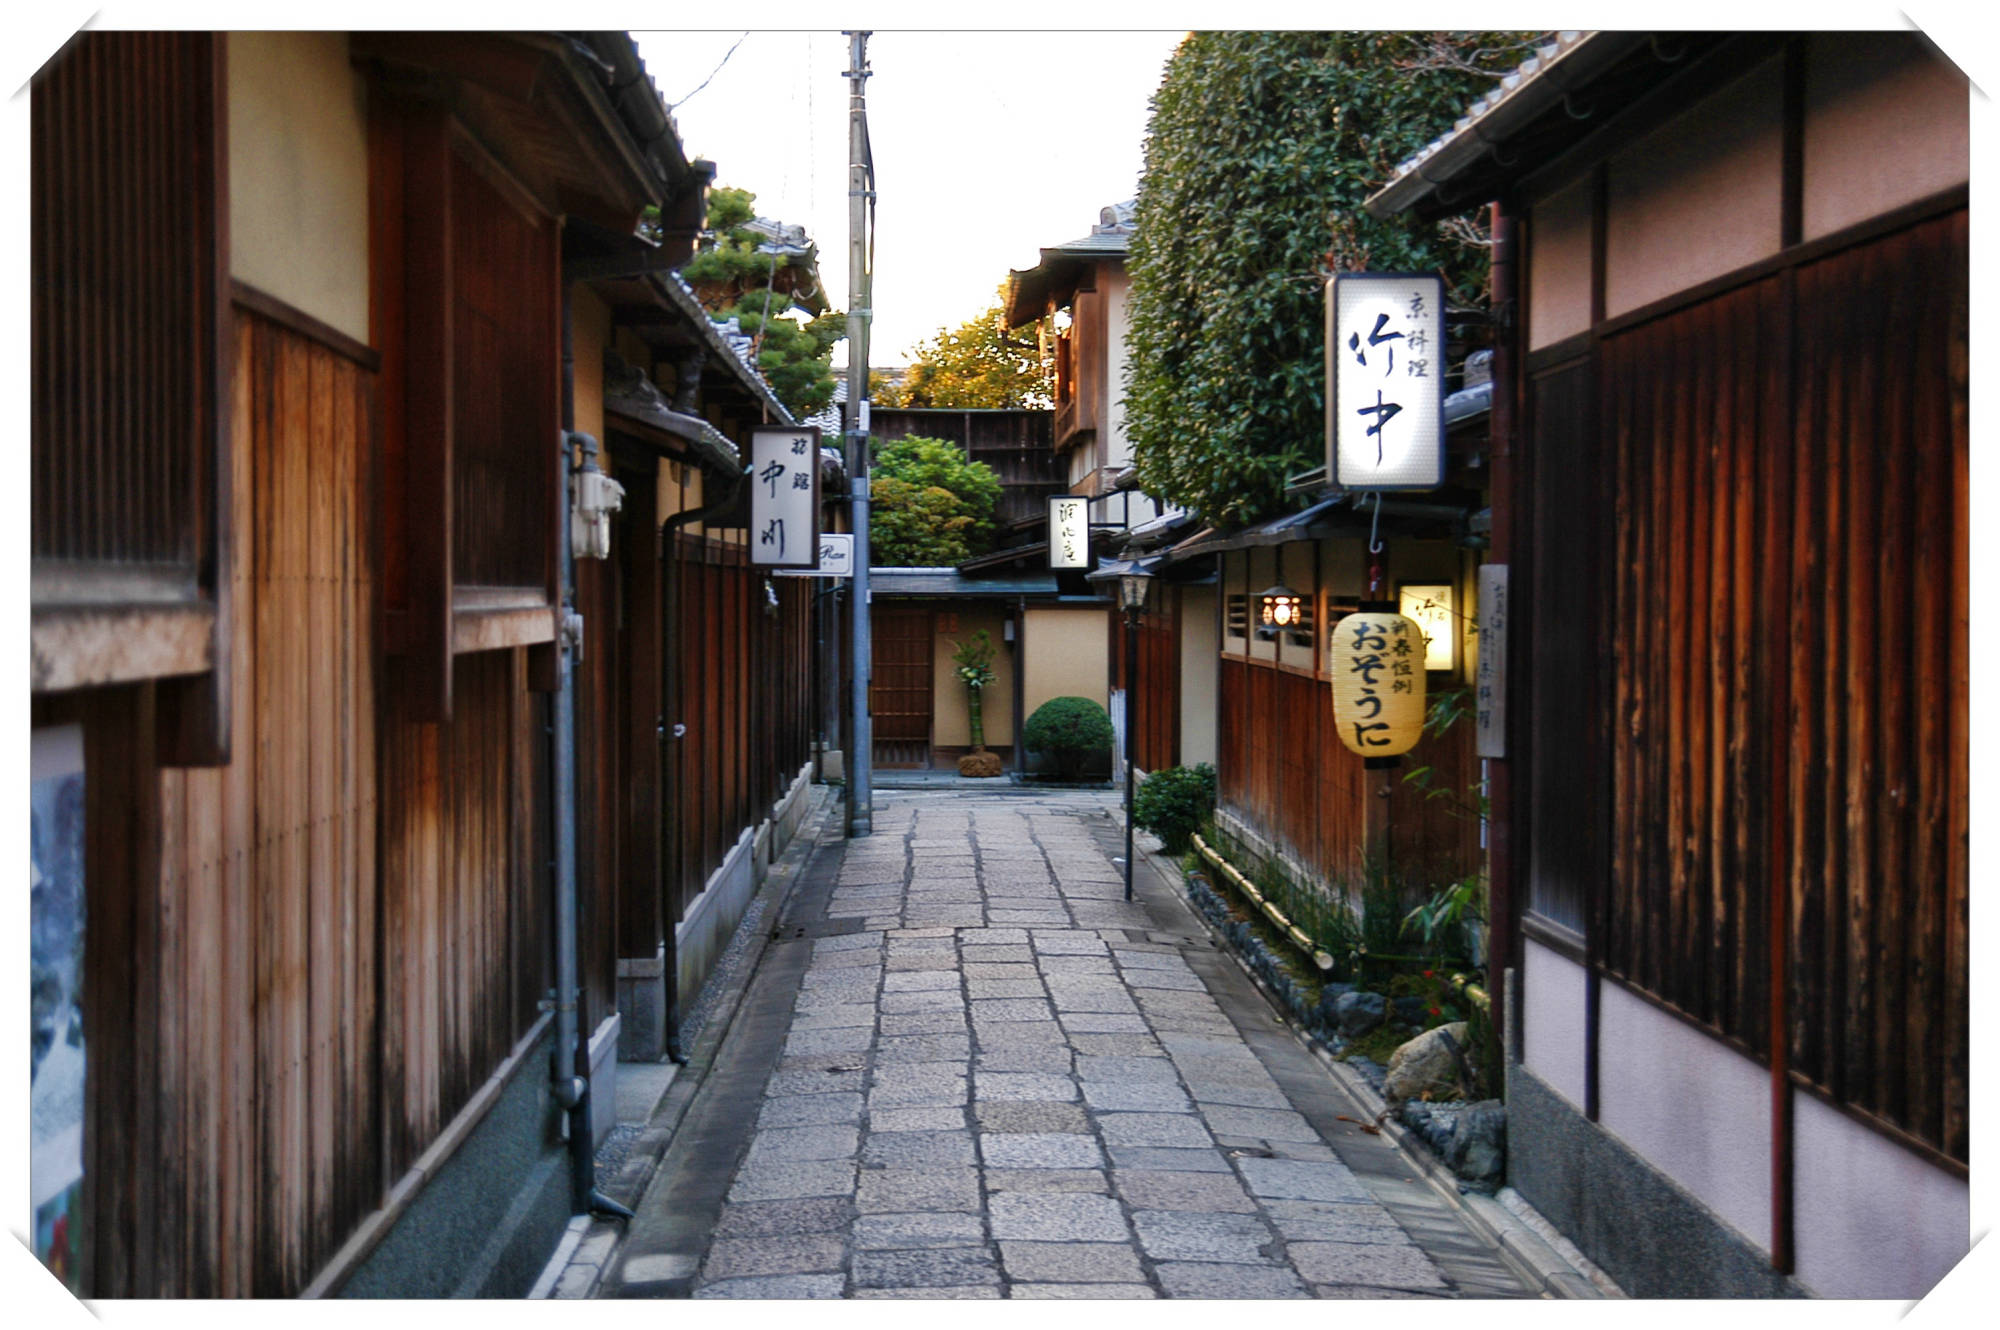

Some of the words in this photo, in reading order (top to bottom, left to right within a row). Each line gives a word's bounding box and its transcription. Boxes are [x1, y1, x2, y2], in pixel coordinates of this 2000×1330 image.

[1406, 292, 1429, 377] 京料理
[1349, 313, 1406, 466] 竹中
[1351, 621, 1391, 747] おぞうに
[1391, 621, 1413, 694] 新春恒例
